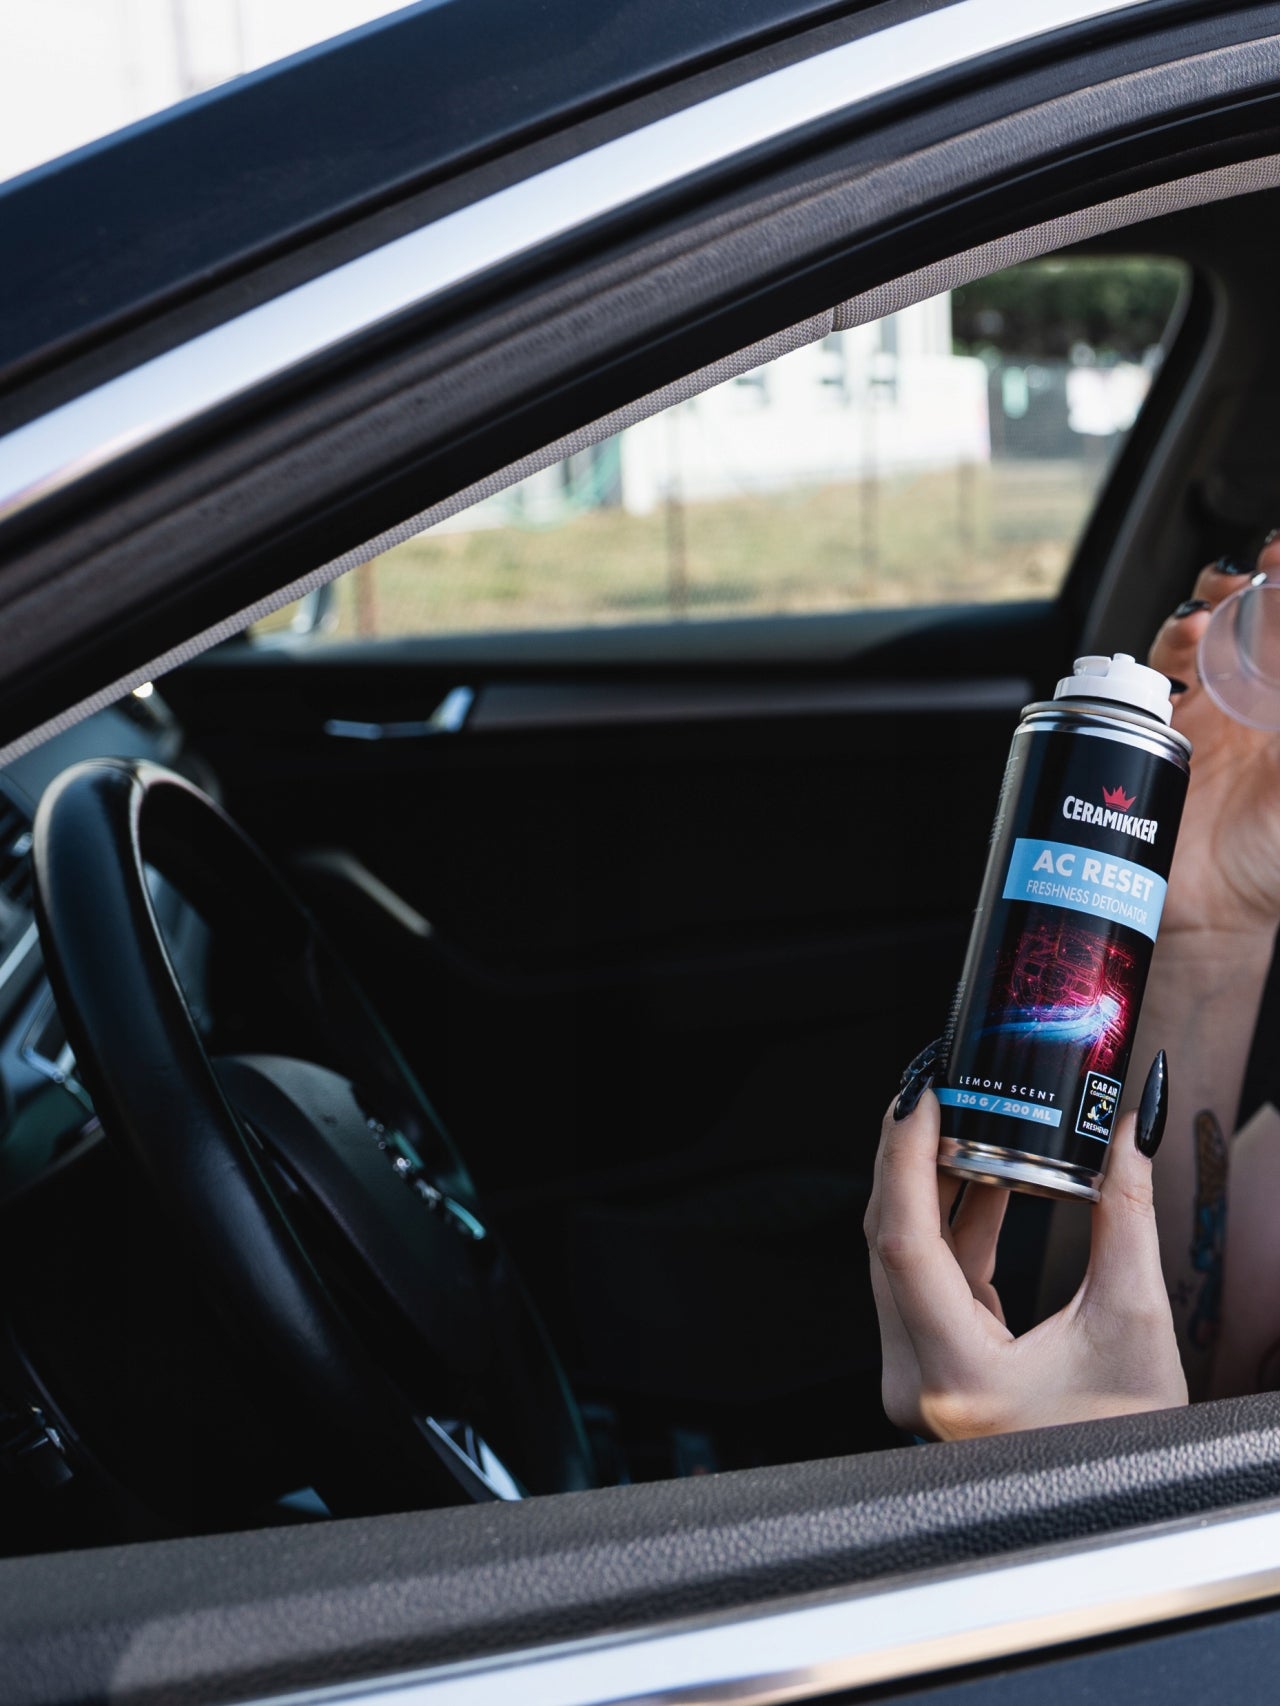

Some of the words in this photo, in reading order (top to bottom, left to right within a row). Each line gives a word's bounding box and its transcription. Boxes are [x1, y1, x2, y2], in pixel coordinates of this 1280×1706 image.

[1062, 795, 1158, 844] CERAMIKKER
[1032, 849, 1076, 877] AC
[1081, 857, 1154, 902] RESET
[1026, 880, 1090, 904] FRESHNESS
[1091, 892, 1148, 925] DETONATOR
[959, 1075, 1003, 1090] LEMON
[1011, 1084, 1055, 1102] SCENT
[1091, 1080, 1108, 1094] CAR
[956, 1093, 977, 1105] 136
[978, 1097, 988, 1107] G
[1002, 1102, 1030, 1116] 200
[1031, 1108, 1051, 1121] ML
